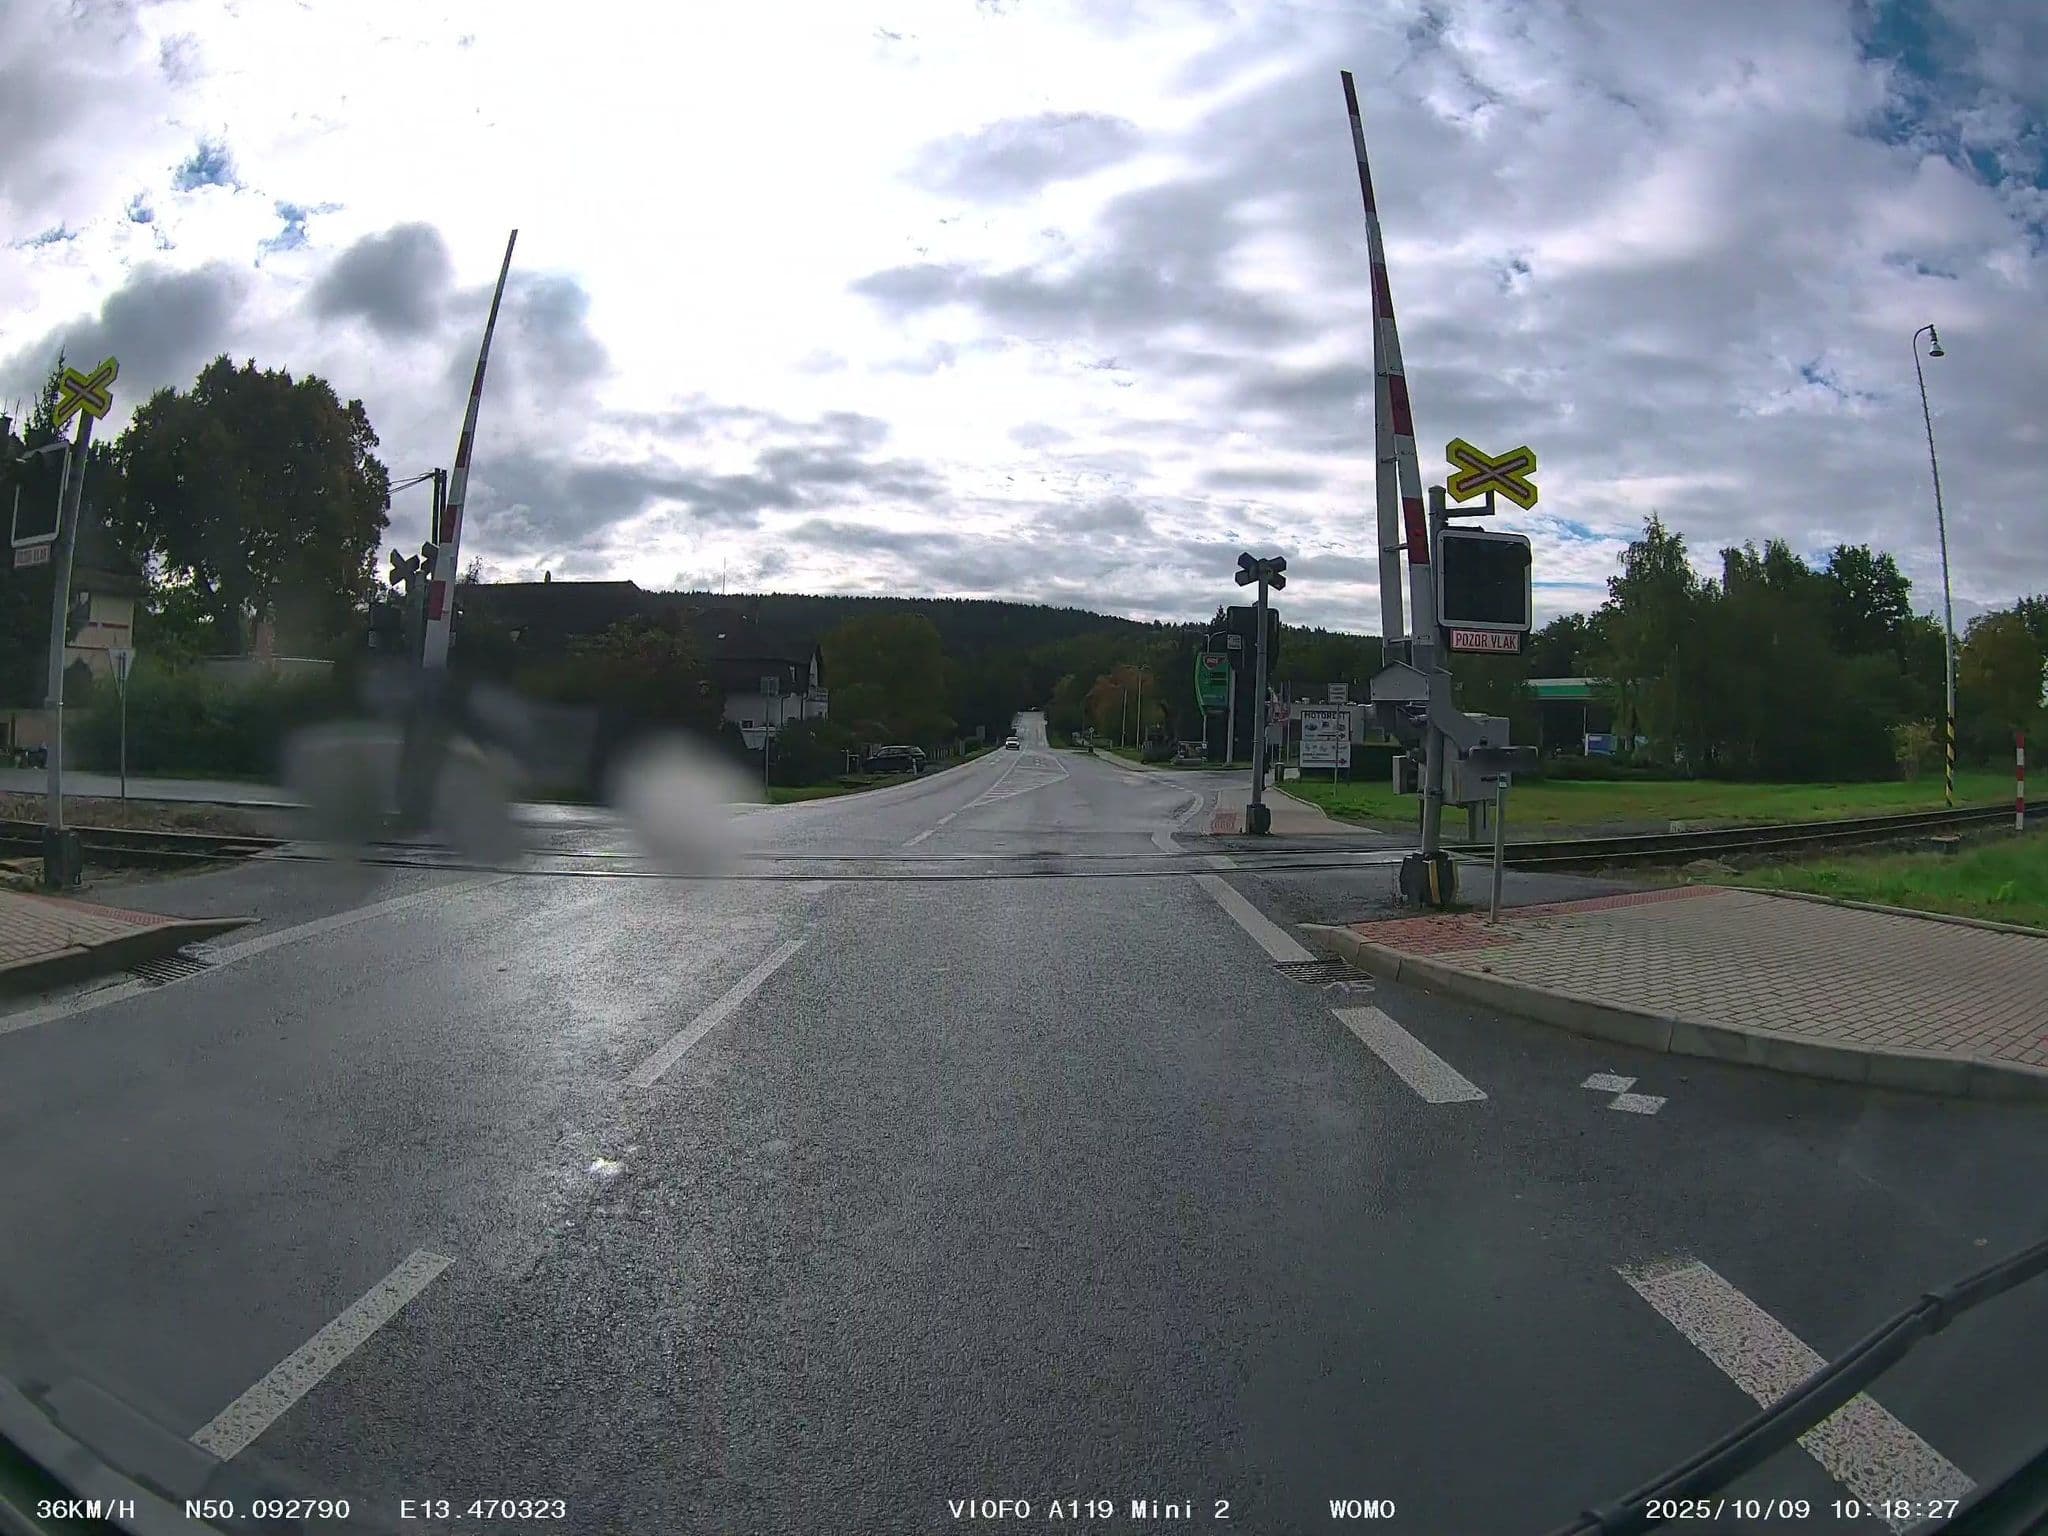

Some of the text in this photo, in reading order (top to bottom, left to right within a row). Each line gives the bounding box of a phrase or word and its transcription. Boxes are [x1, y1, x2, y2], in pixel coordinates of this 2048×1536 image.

[1454, 632, 1517, 649] POZOR VLAK
[1304, 711, 1346, 720] MOTORET
